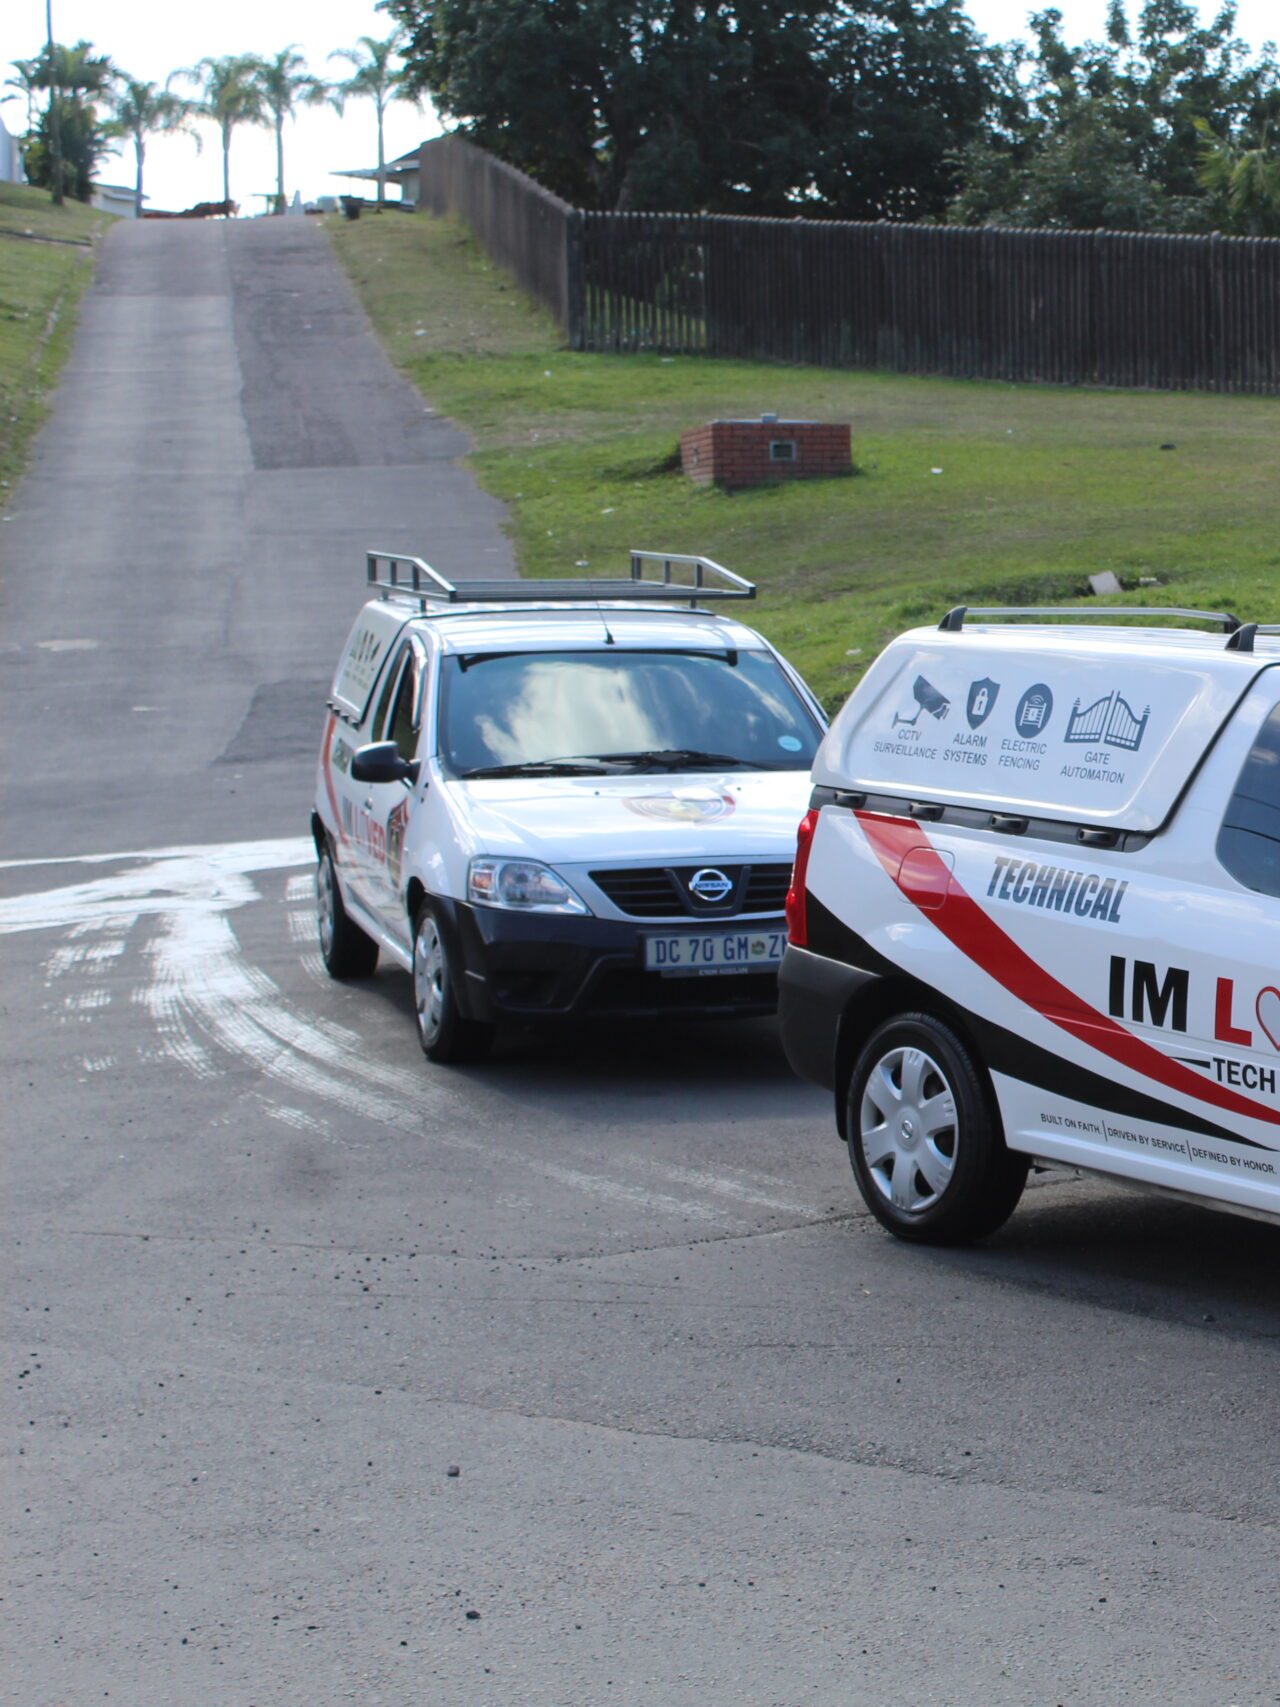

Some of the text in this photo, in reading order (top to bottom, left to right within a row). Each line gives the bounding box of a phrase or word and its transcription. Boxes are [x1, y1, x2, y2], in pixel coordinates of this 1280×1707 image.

[898, 729, 922, 741] CCTV
[953, 733, 988, 748] ALARM
[873, 742, 937, 760] SURVEILLANCE
[1001, 739, 1047, 755] ELECTRIC
[943, 749, 988, 766] SYSTEMS
[998, 755, 1040, 771] FENCING
[1084, 751, 1110, 765] GATE
[1060, 765, 1125, 784] AUTOMATION
[986, 856, 1129, 924] TECHNICAL
[655, 939, 680, 963] DC
[689, 938, 714, 962] 70
[724, 936, 748, 960] GM
[1109, 955, 1189, 1033] IM
[1212, 1057, 1276, 1094] TECH
[1040, 1113, 1278, 1174] BUILT ON FAITH. DRIVEN BY SERVICE DEFINED BY HONOR.
